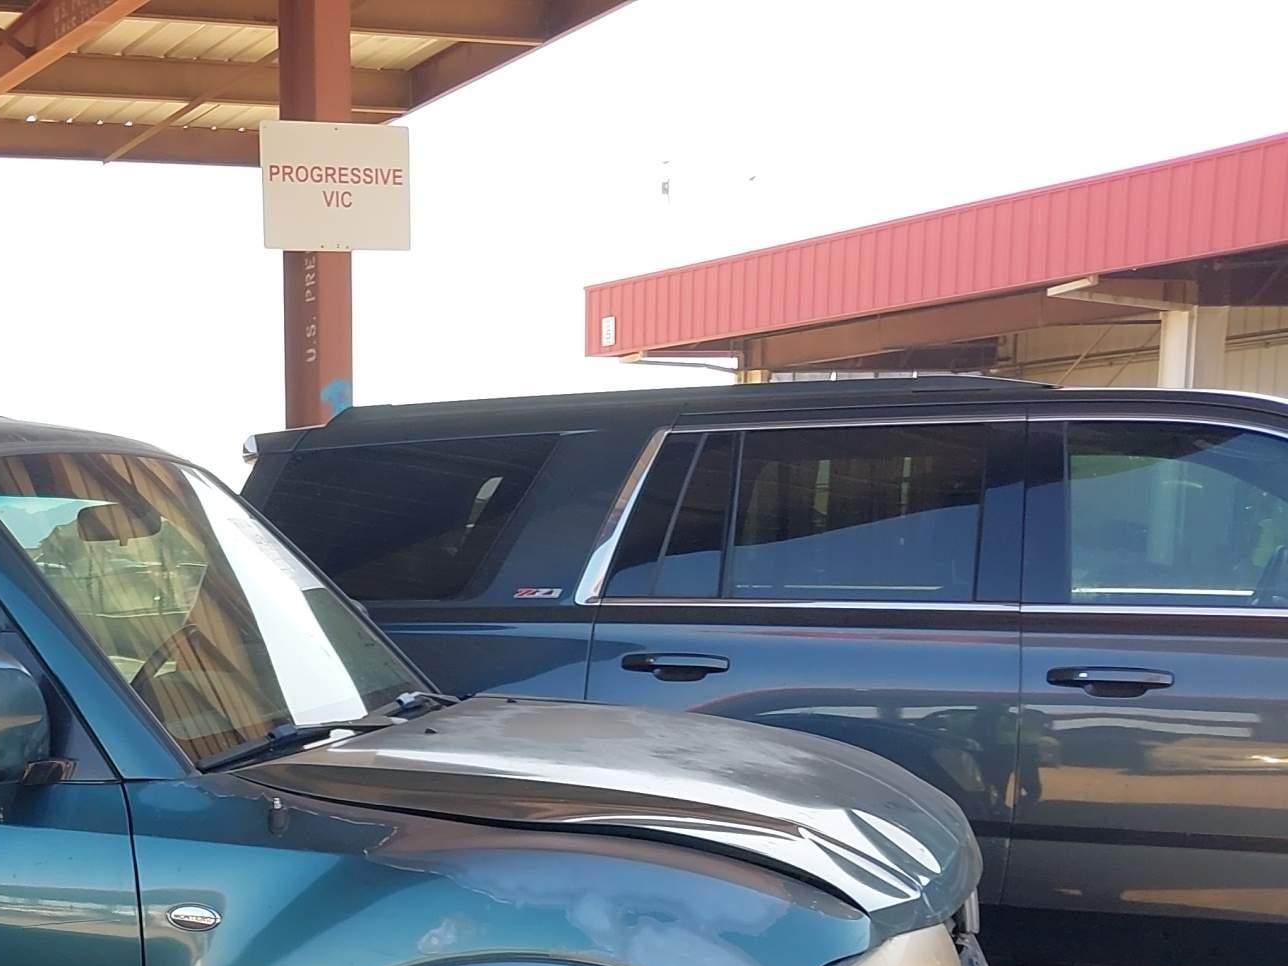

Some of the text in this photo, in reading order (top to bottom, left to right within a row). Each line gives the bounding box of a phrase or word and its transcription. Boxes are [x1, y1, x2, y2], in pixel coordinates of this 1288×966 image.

[268, 164, 404, 186] PROGRESSIVE
[322, 190, 353, 208] VIC
[304, 251, 317, 303] PRE
